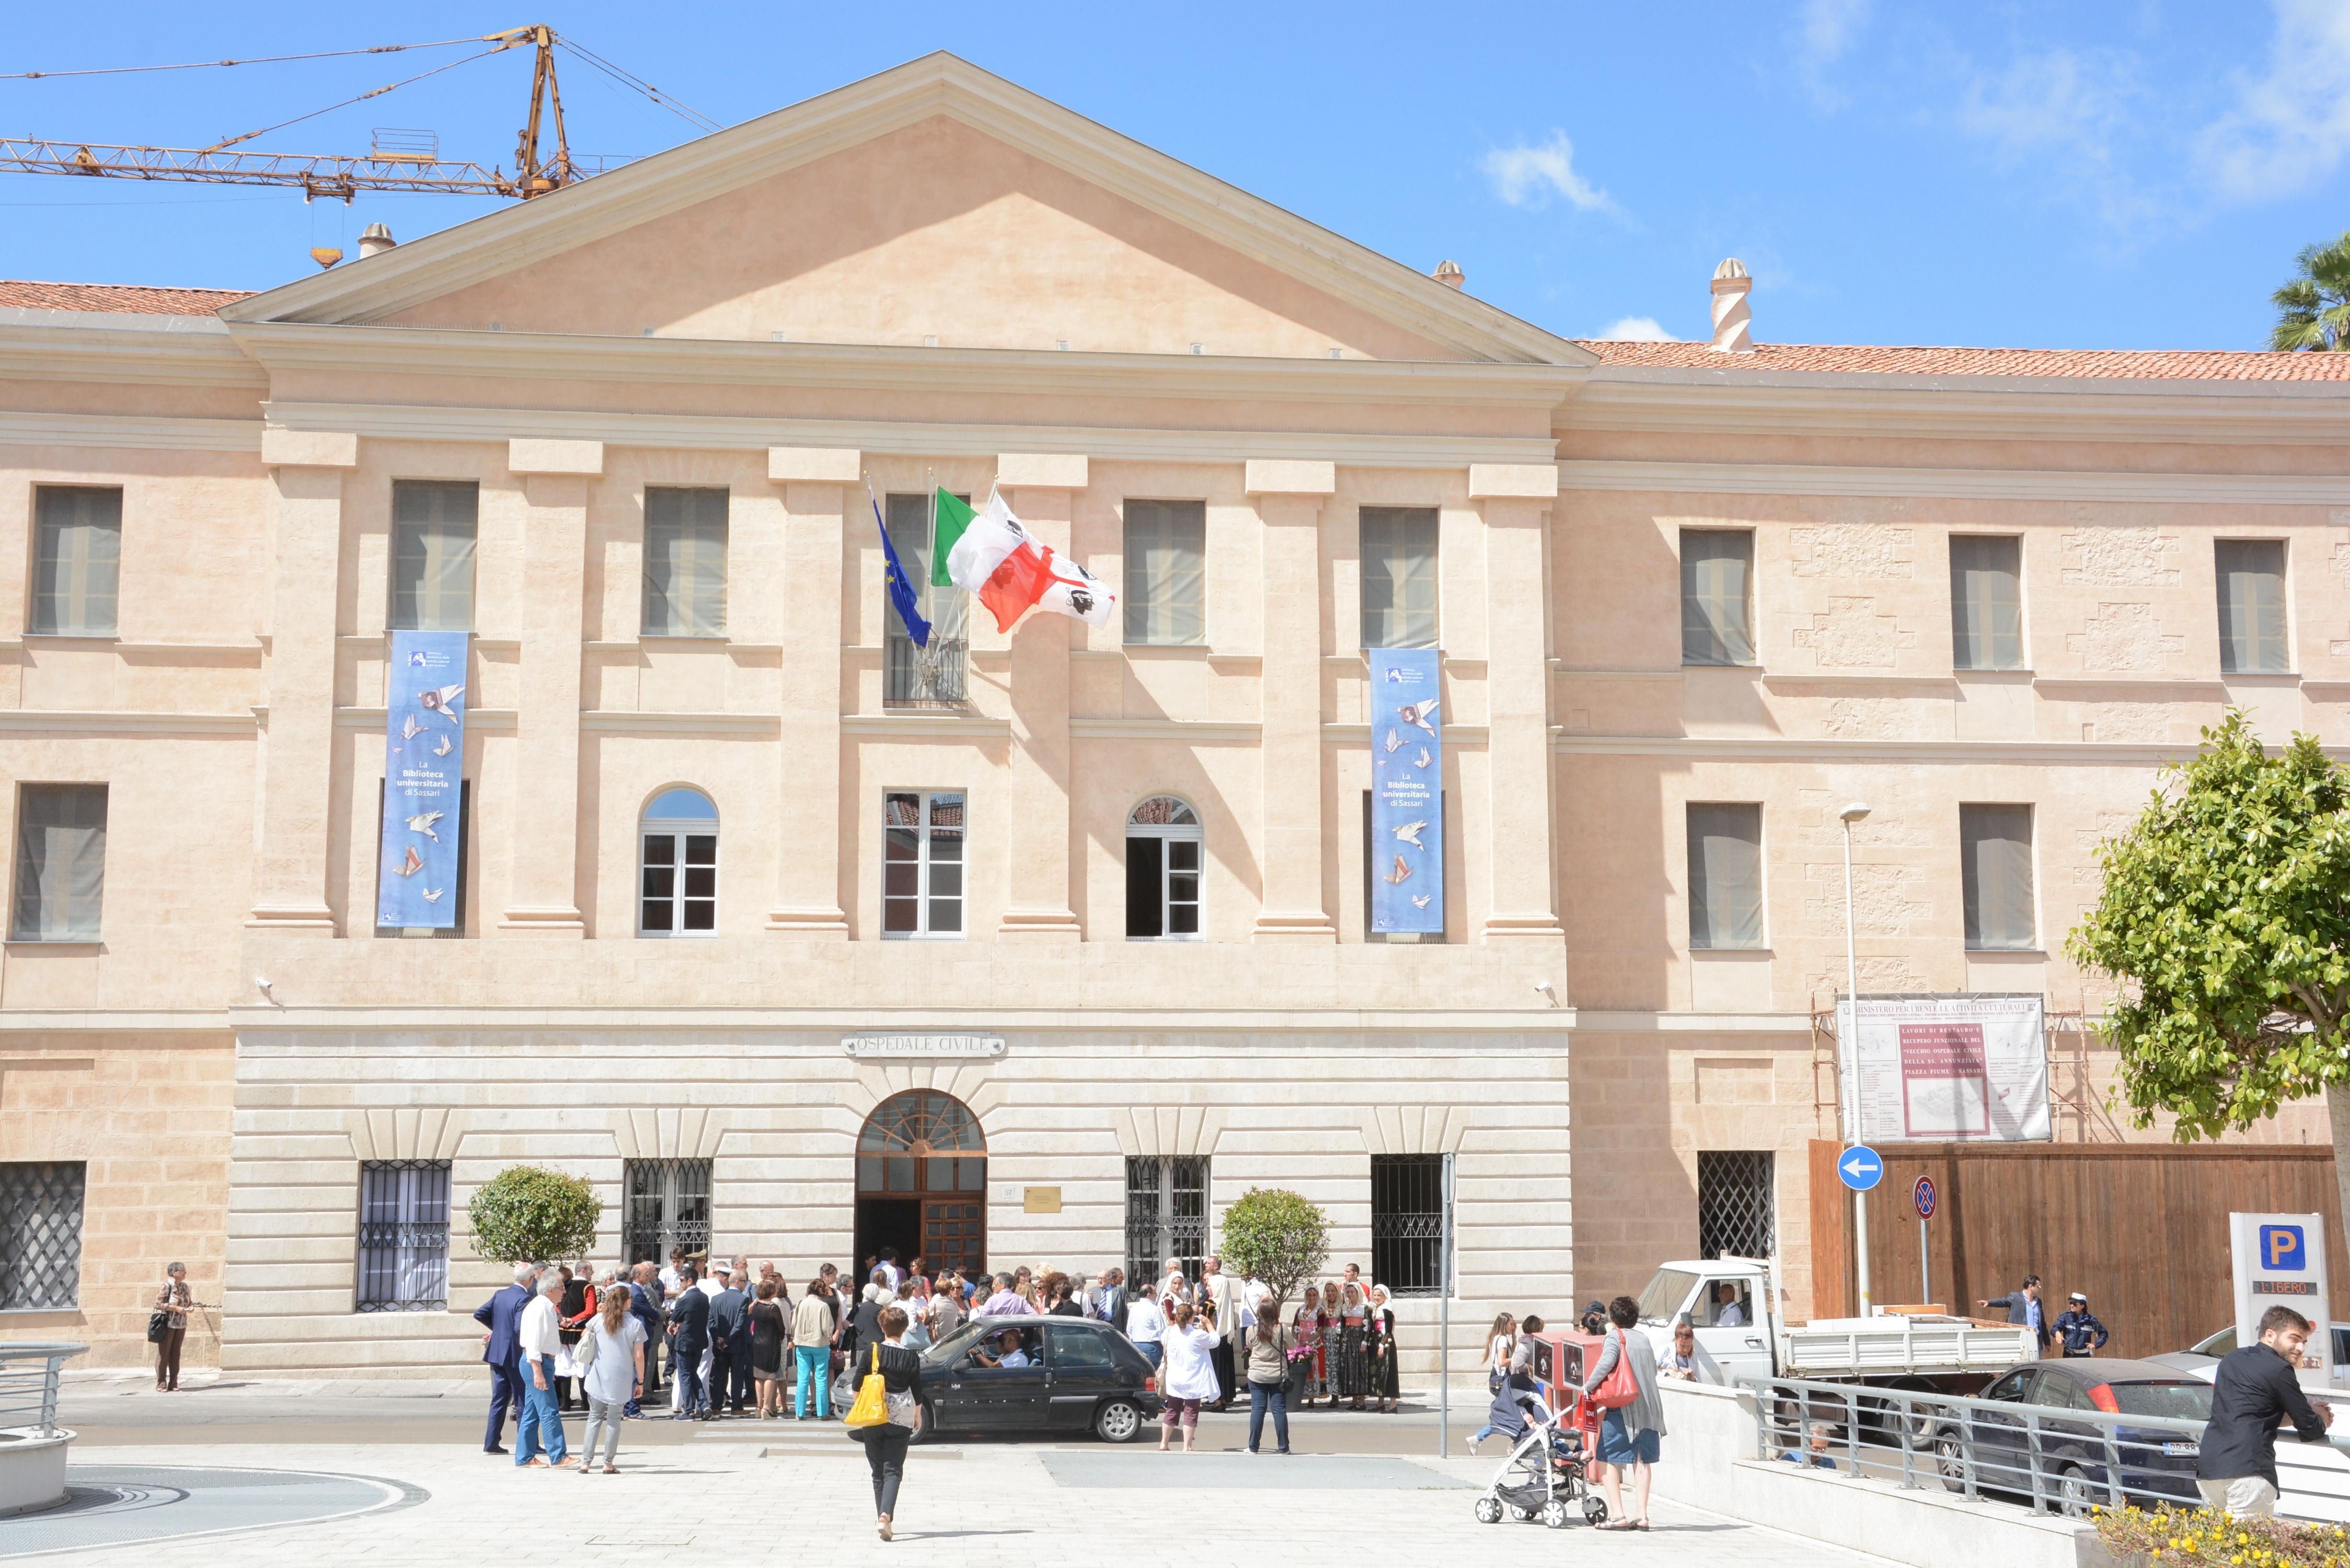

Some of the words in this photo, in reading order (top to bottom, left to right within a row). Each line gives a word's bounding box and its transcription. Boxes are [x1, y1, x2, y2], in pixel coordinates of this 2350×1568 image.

[857, 1037, 932, 1050] OSPEDALE
[939, 1037, 988, 1050] CIVILE
[2270, 1230, 2297, 1264] P
[2261, 1282, 2307, 1294] LIBERO
